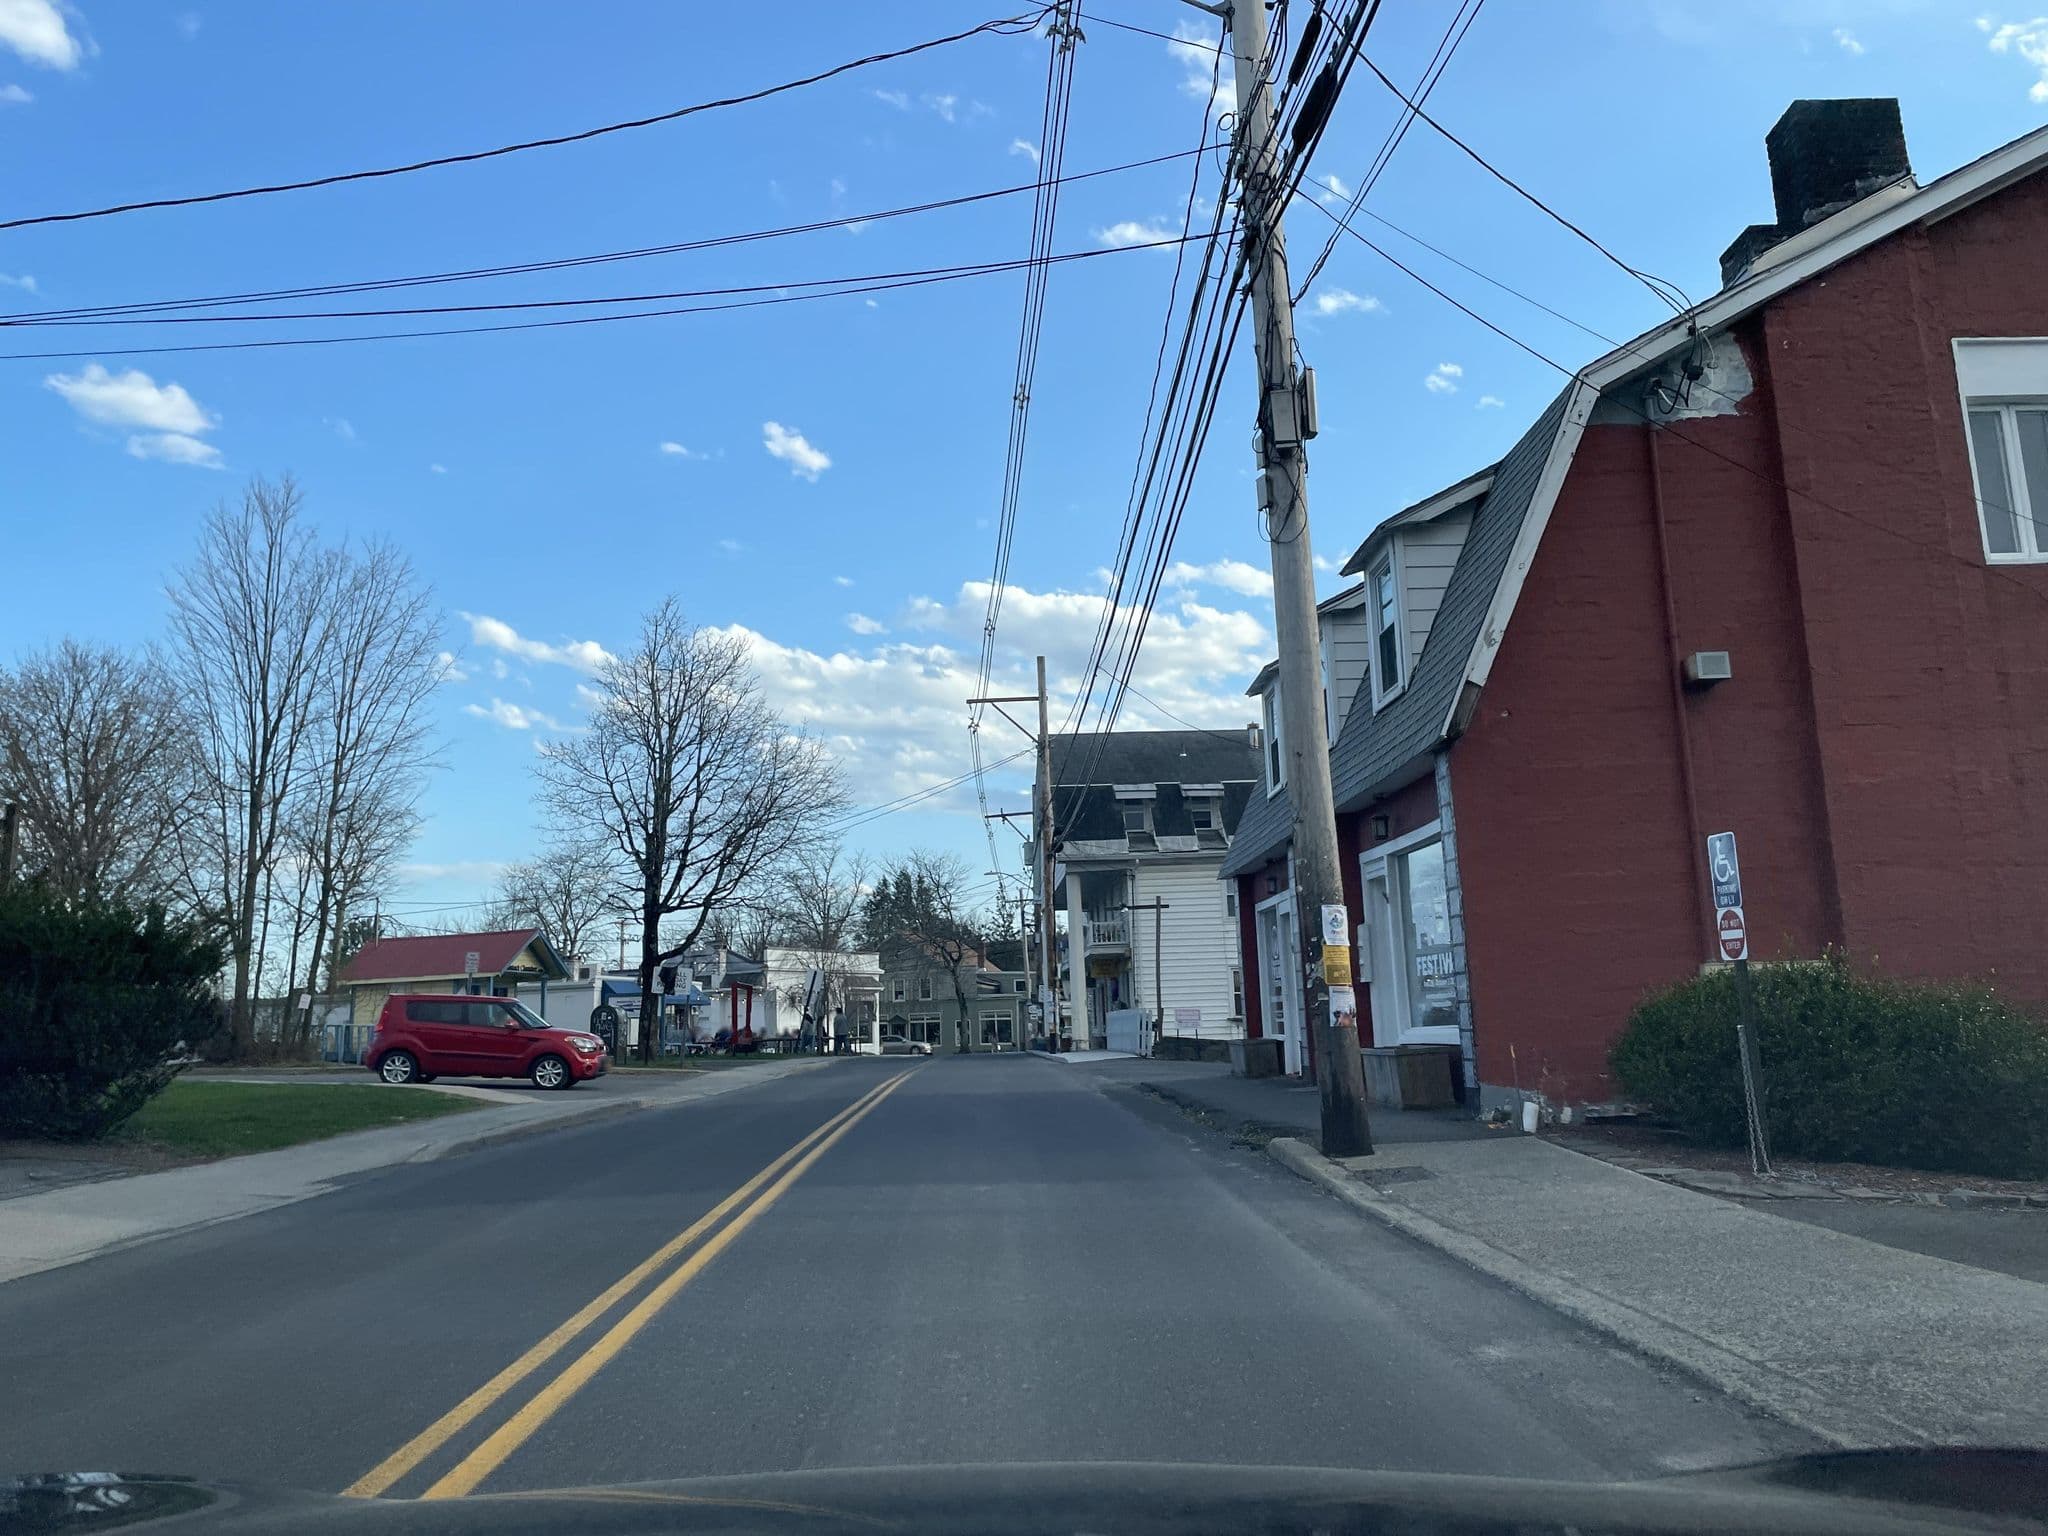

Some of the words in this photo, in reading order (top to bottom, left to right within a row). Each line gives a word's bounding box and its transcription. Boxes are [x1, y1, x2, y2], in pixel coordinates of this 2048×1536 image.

[1720, 895, 1735, 905] ONLY
[1721, 919, 1729, 928] DO
[1729, 918, 1740, 927] NOT
[1725, 941, 1741, 950] ENTER
